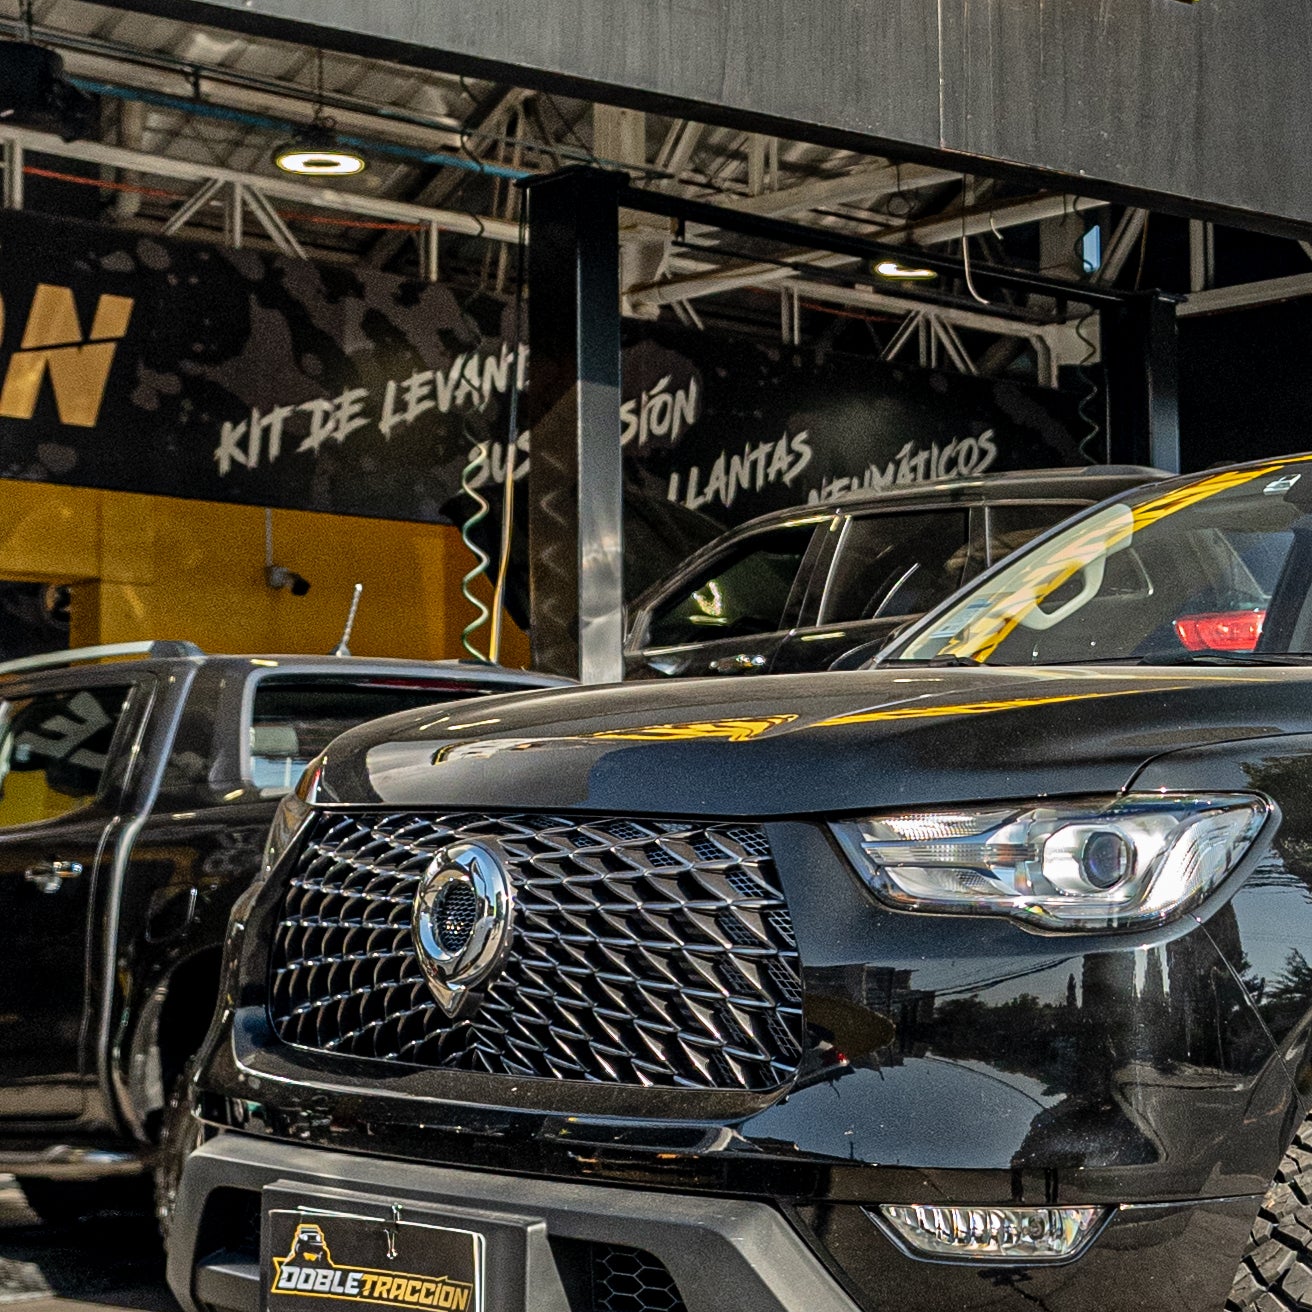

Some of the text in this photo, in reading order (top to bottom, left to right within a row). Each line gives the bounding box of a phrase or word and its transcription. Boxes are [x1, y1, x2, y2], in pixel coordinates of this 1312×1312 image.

[0, 283, 135, 428] N
[213, 341, 530, 477] KIT DE LEVANT
